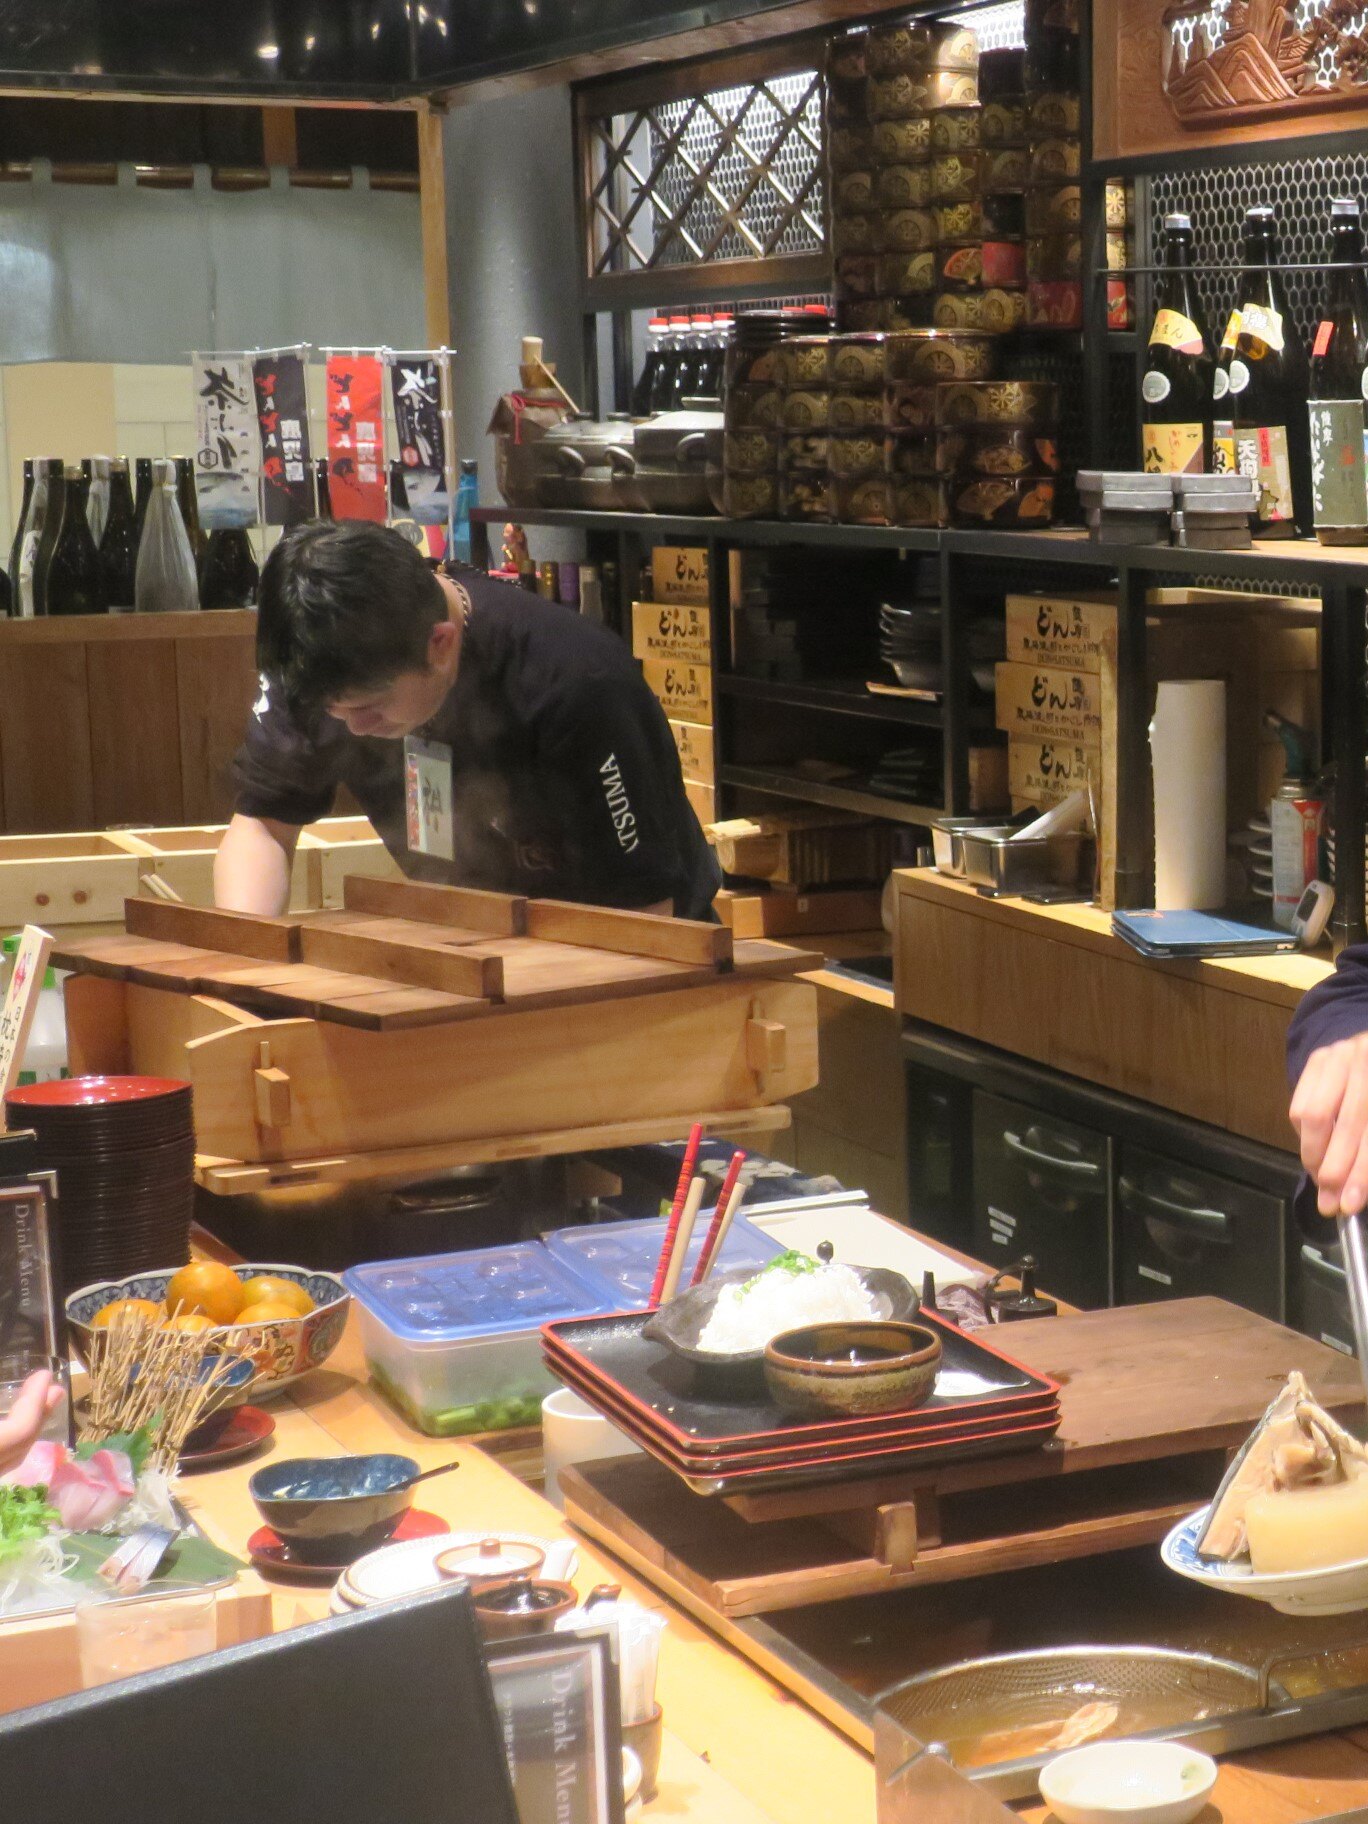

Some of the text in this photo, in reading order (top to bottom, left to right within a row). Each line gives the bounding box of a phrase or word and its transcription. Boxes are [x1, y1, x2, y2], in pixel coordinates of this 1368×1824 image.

[15, 1204, 33, 1253] Drink
[551, 1671, 578, 1824] Drink Men
